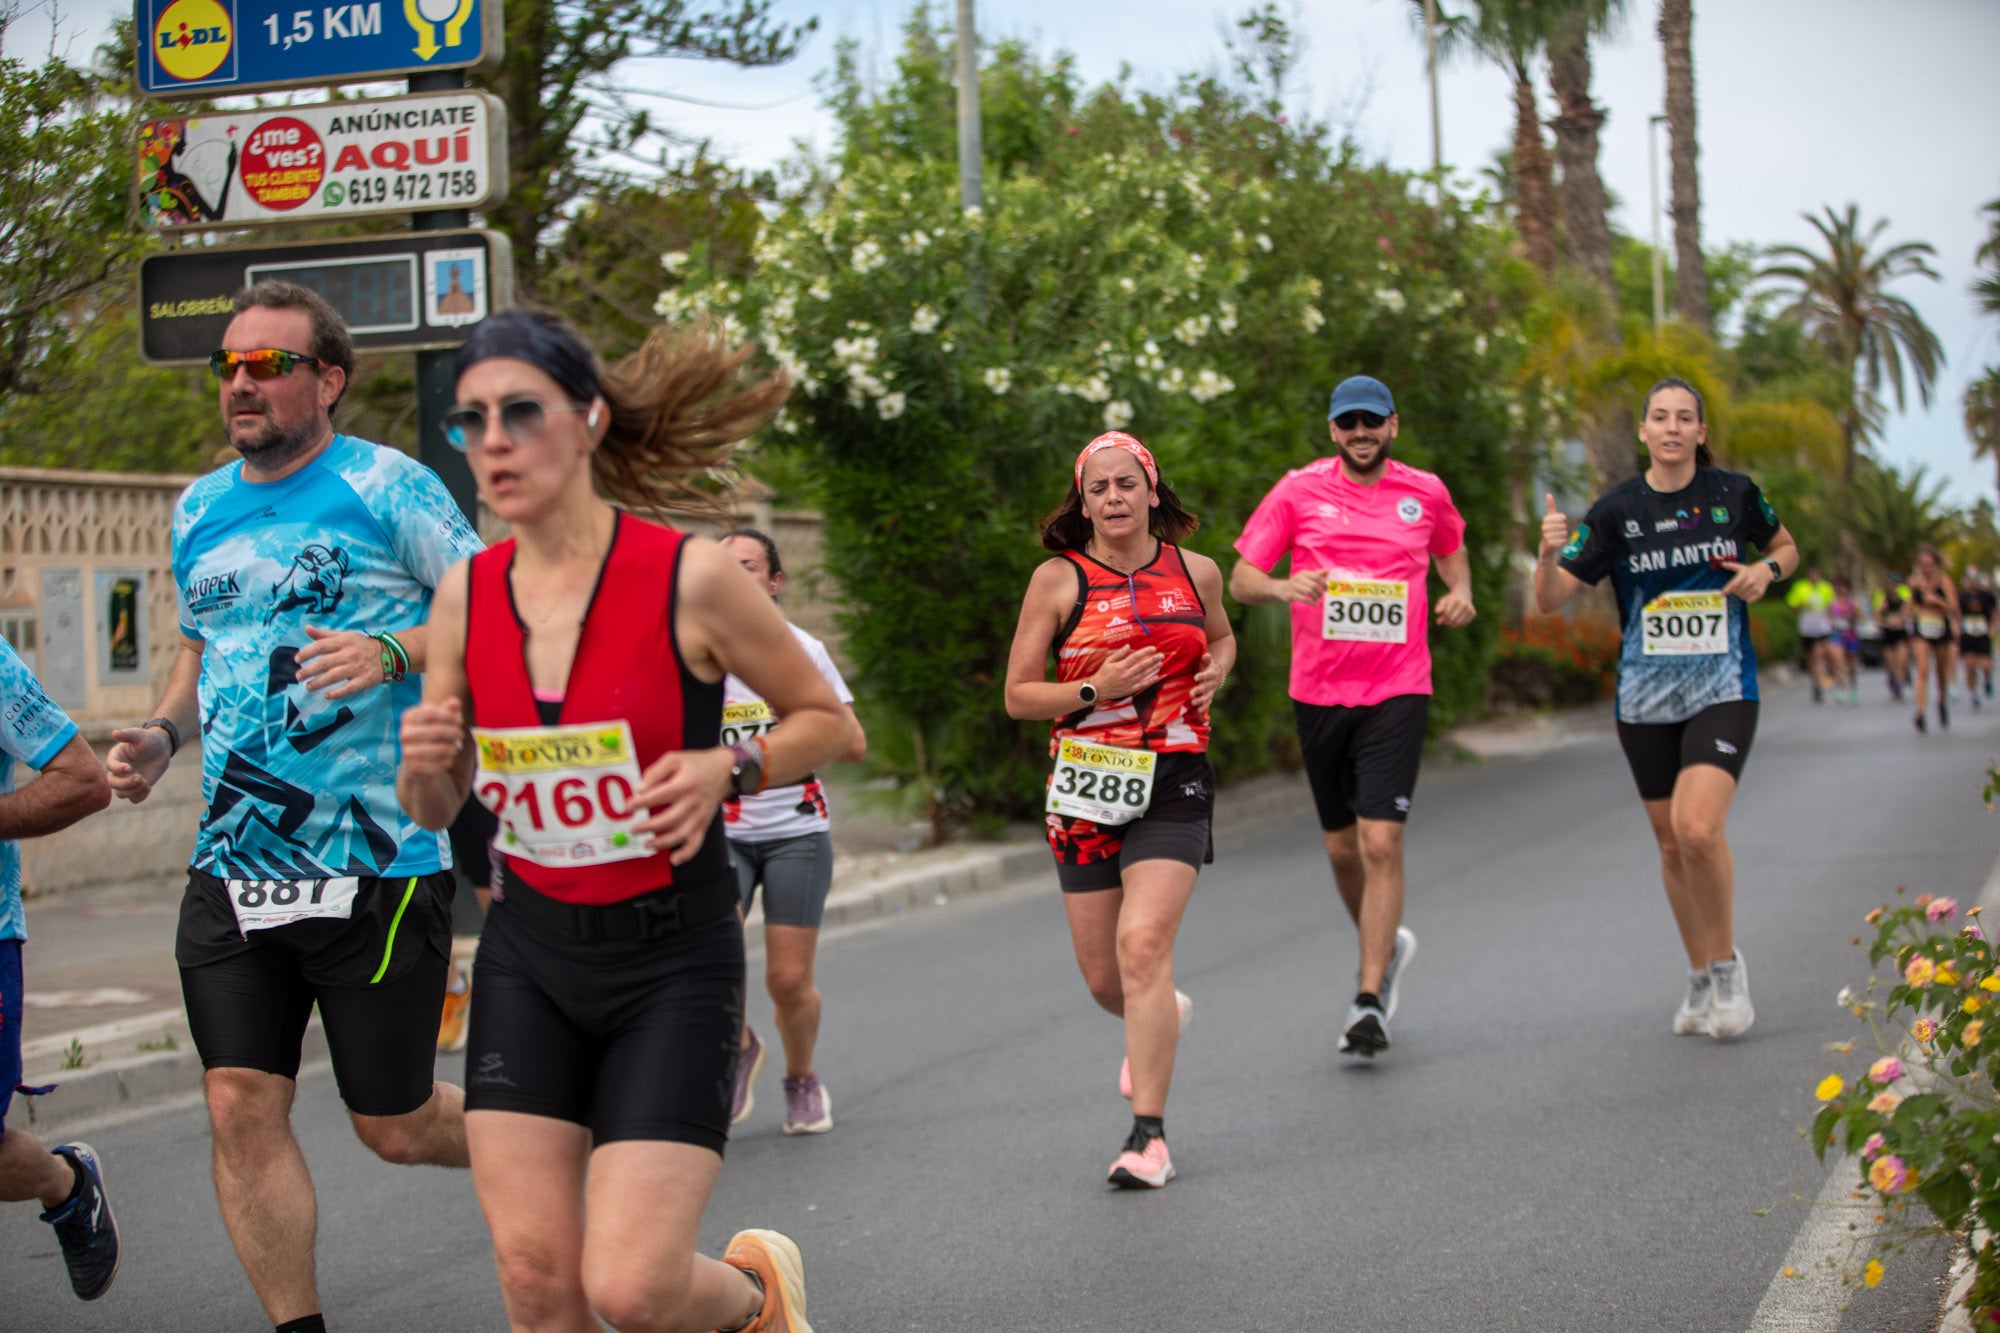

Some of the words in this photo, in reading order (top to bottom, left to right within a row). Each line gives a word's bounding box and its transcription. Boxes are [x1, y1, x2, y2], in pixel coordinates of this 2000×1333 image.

[263, 10, 314, 50] 1,5
[323, 2, 382, 40] KM
[328, 106, 476, 136] ANÚNCIATE
[249, 127, 301, 155] ¿me
[265, 142, 322, 169] ves?
[332, 127, 471, 173] AQUÍ
[349, 177, 387, 205] 619
[393, 173, 431, 201] 472
[438, 169, 477, 197] 758
[1628, 549, 1667, 574] SAN
[1671, 536, 1738, 567] ANTÓN
[1328, 600, 1403, 626] 3006
[1647, 614, 1723, 638] 3007
[481, 773, 635, 832] 2160
[1056, 766, 1146, 808] 3288
